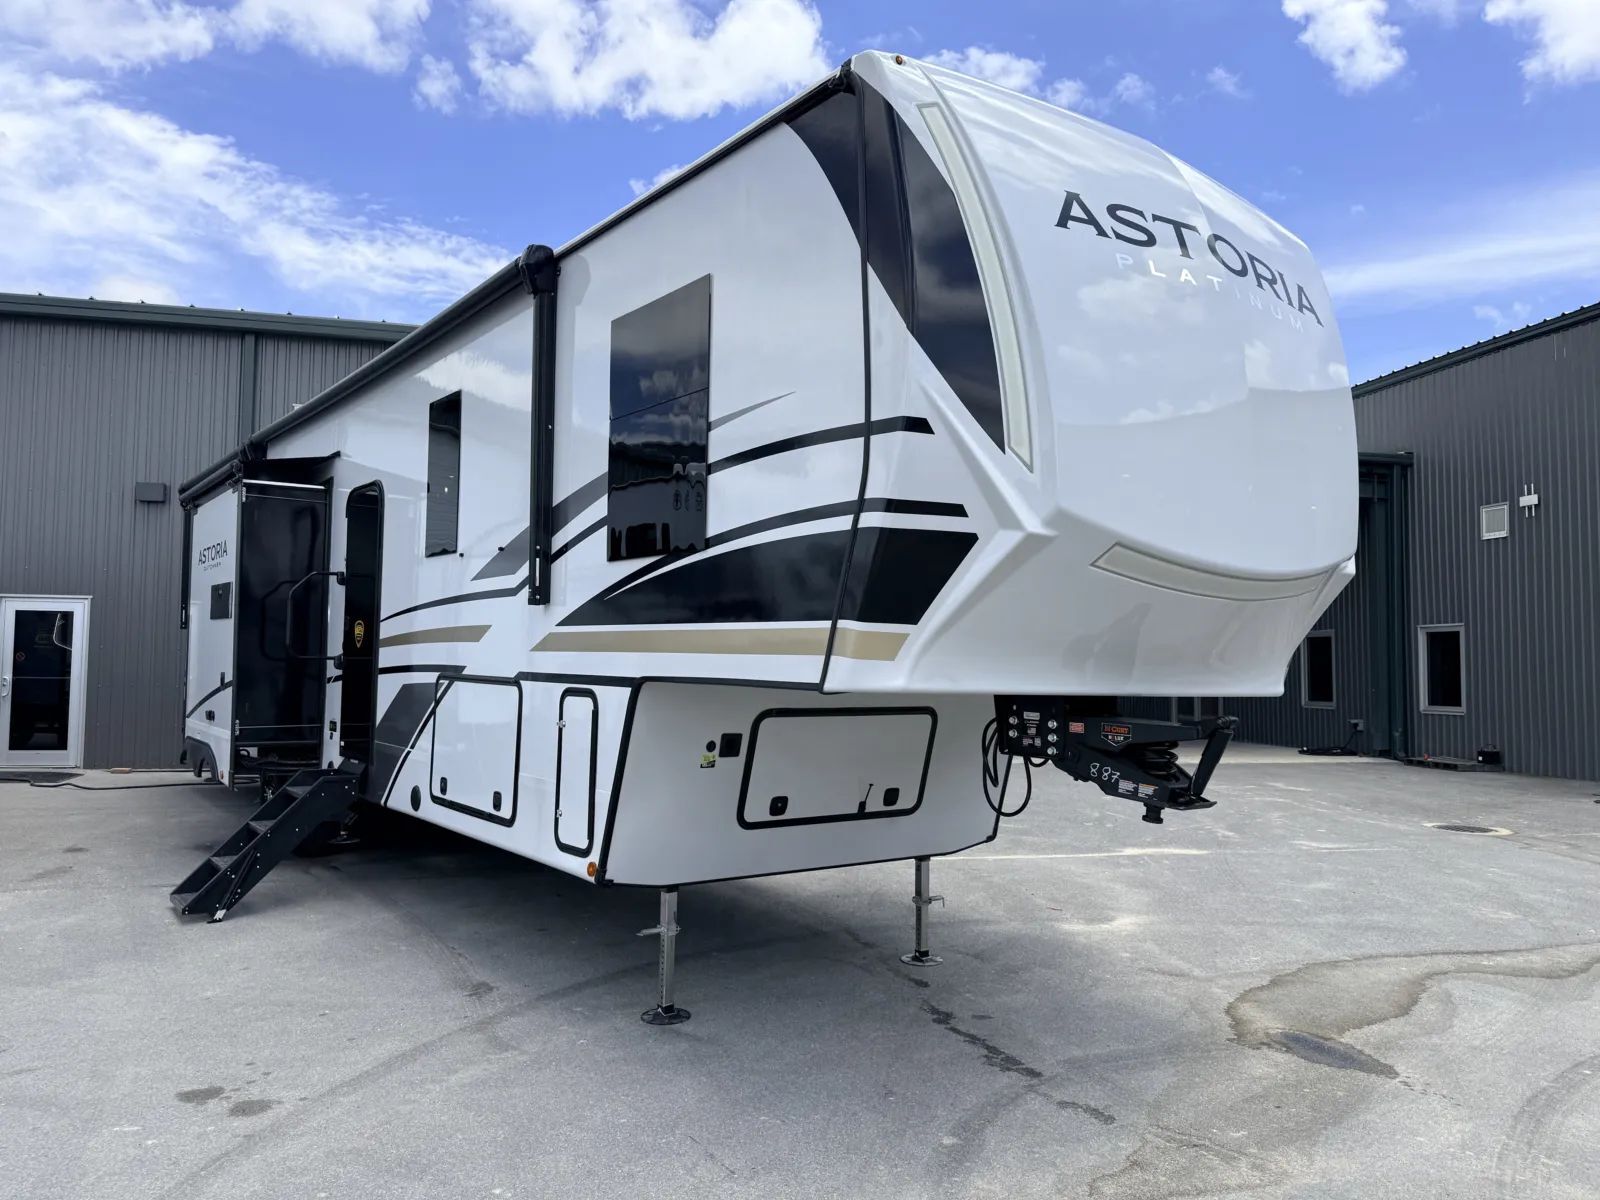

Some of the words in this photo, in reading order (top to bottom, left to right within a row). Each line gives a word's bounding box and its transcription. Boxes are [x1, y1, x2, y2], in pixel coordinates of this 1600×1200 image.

[1054, 190, 1324, 327] ASTORIA
[1115, 253, 1305, 334] PLATINUM
[198, 539, 228, 566] ASTORIA
[1090, 762, 1121, 783] 887
